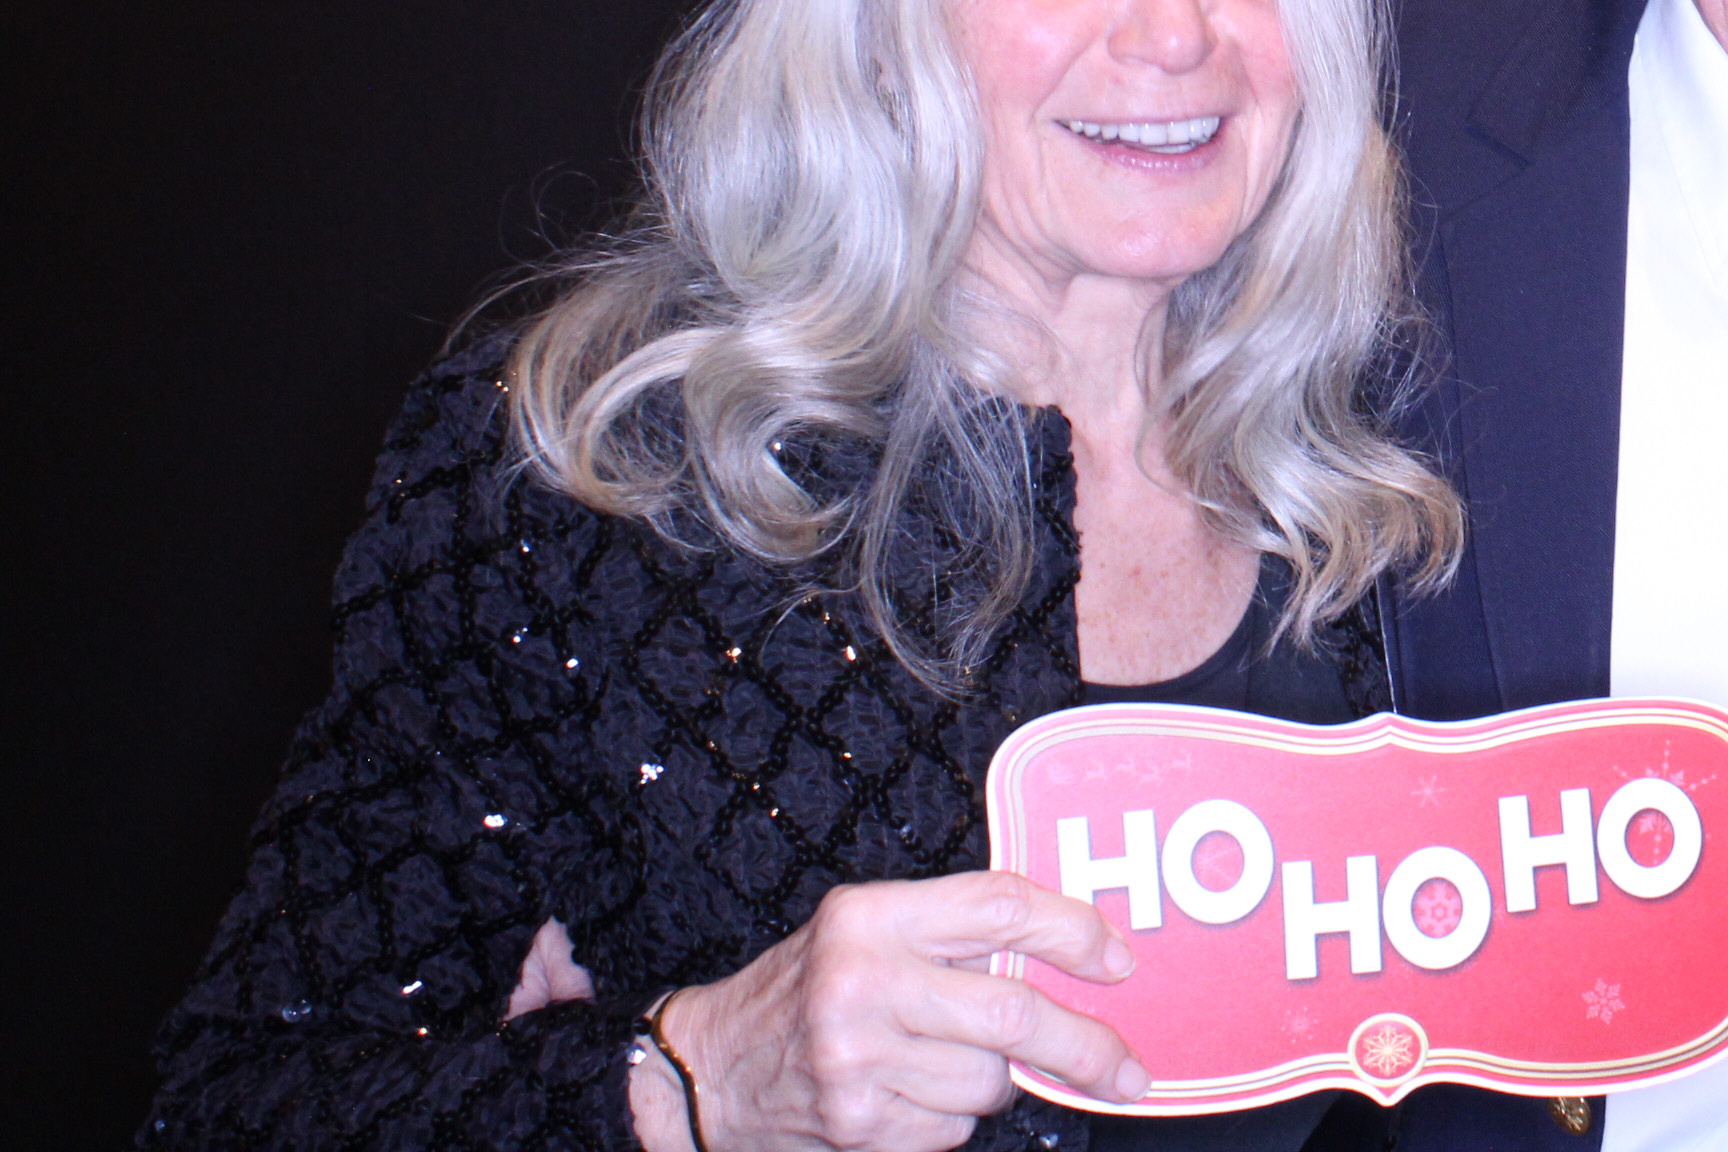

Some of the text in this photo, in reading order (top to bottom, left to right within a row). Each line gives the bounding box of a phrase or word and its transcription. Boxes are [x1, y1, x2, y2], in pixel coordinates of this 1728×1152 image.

[1056, 776, 1703, 981] HO HO HO
